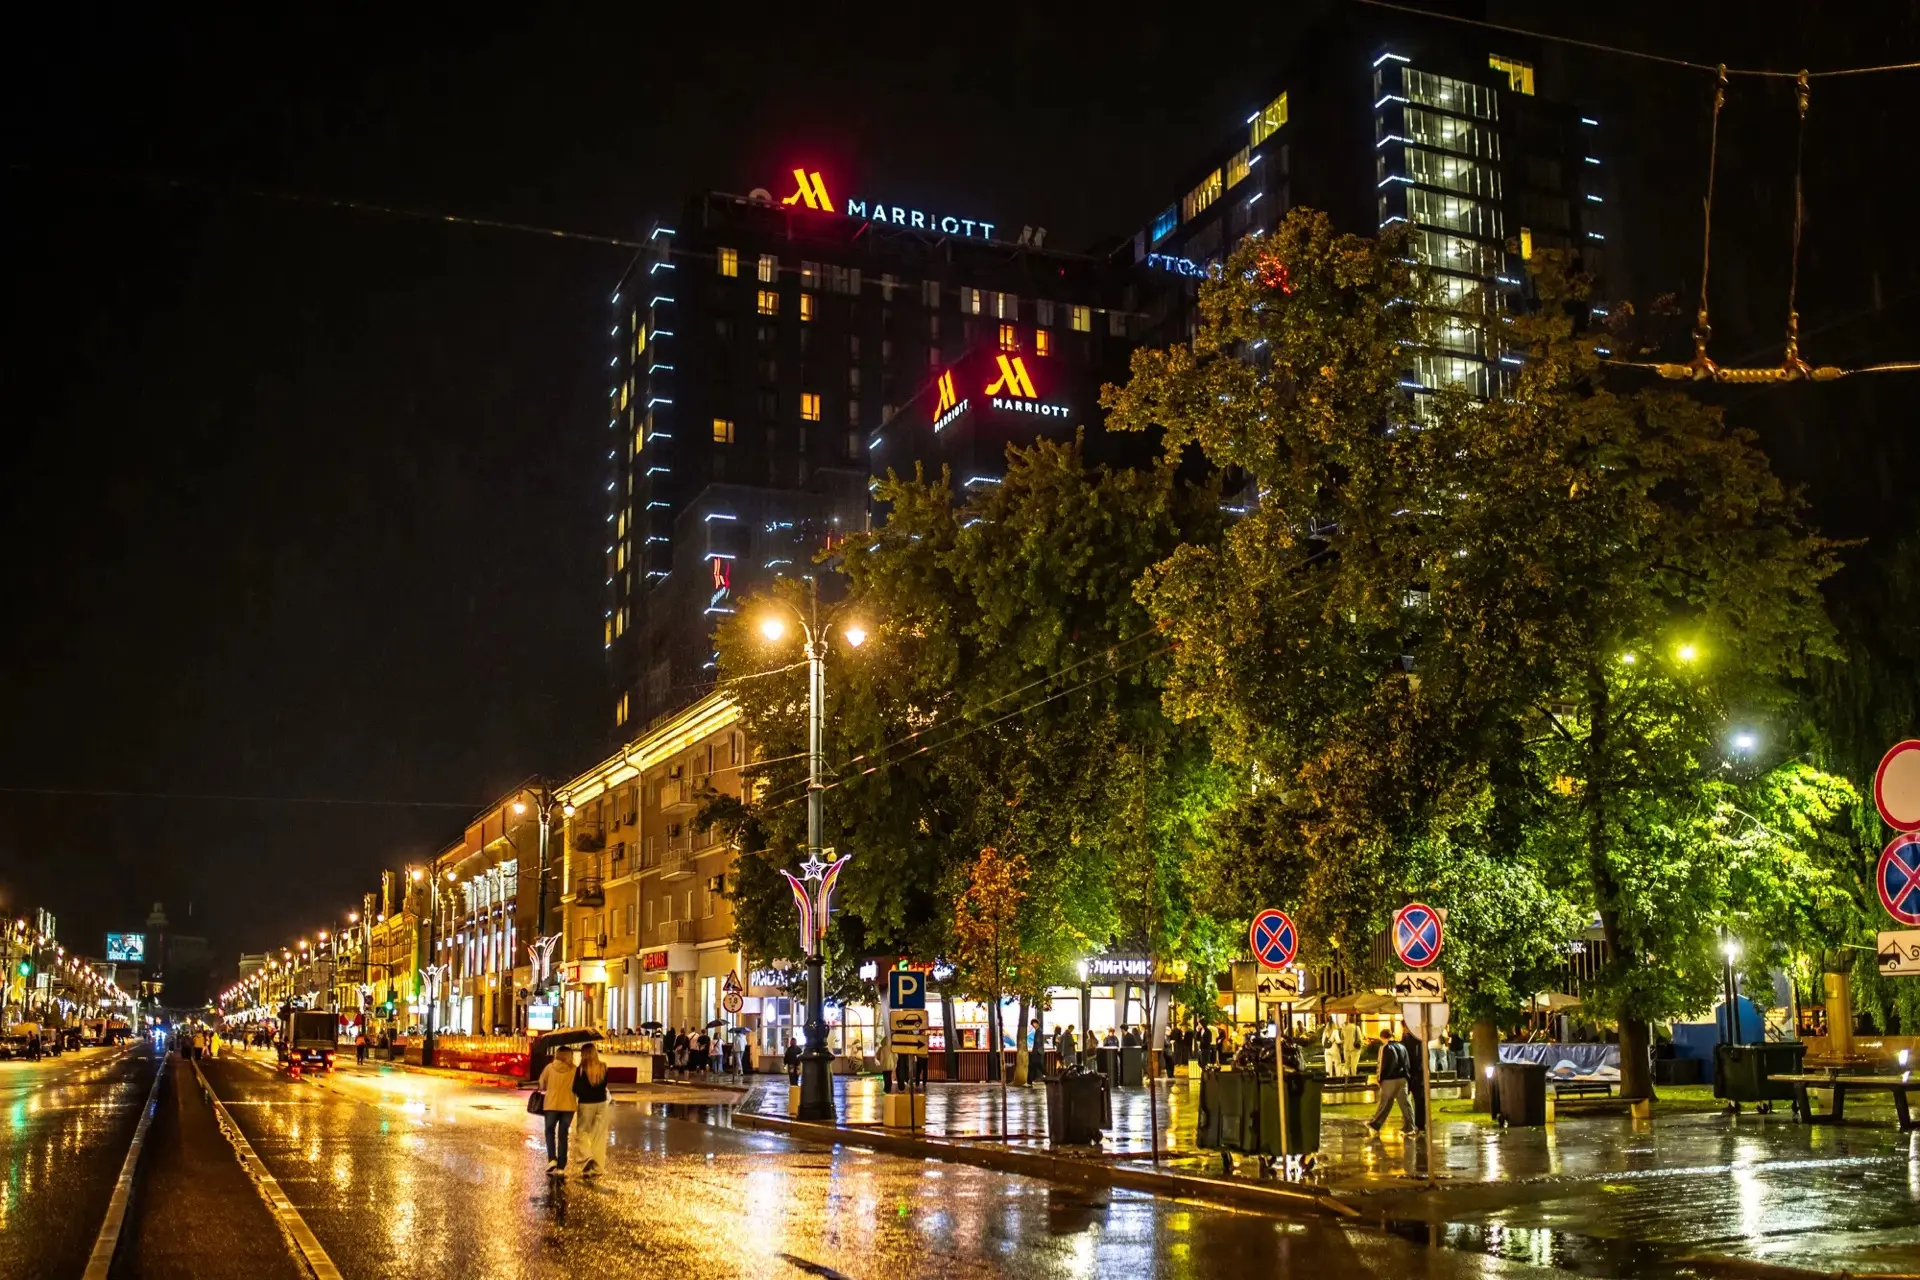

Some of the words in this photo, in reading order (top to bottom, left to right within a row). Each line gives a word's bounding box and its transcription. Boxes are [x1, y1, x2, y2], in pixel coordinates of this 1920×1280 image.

[848, 199, 994, 239] MARRIOTT
[934, 399, 968, 433] MARRIOTT
[993, 398, 1069, 418] MARRIOTT
[1089, 959, 1152, 976] ЛИНЧИК
[898, 975, 918, 1005] P
